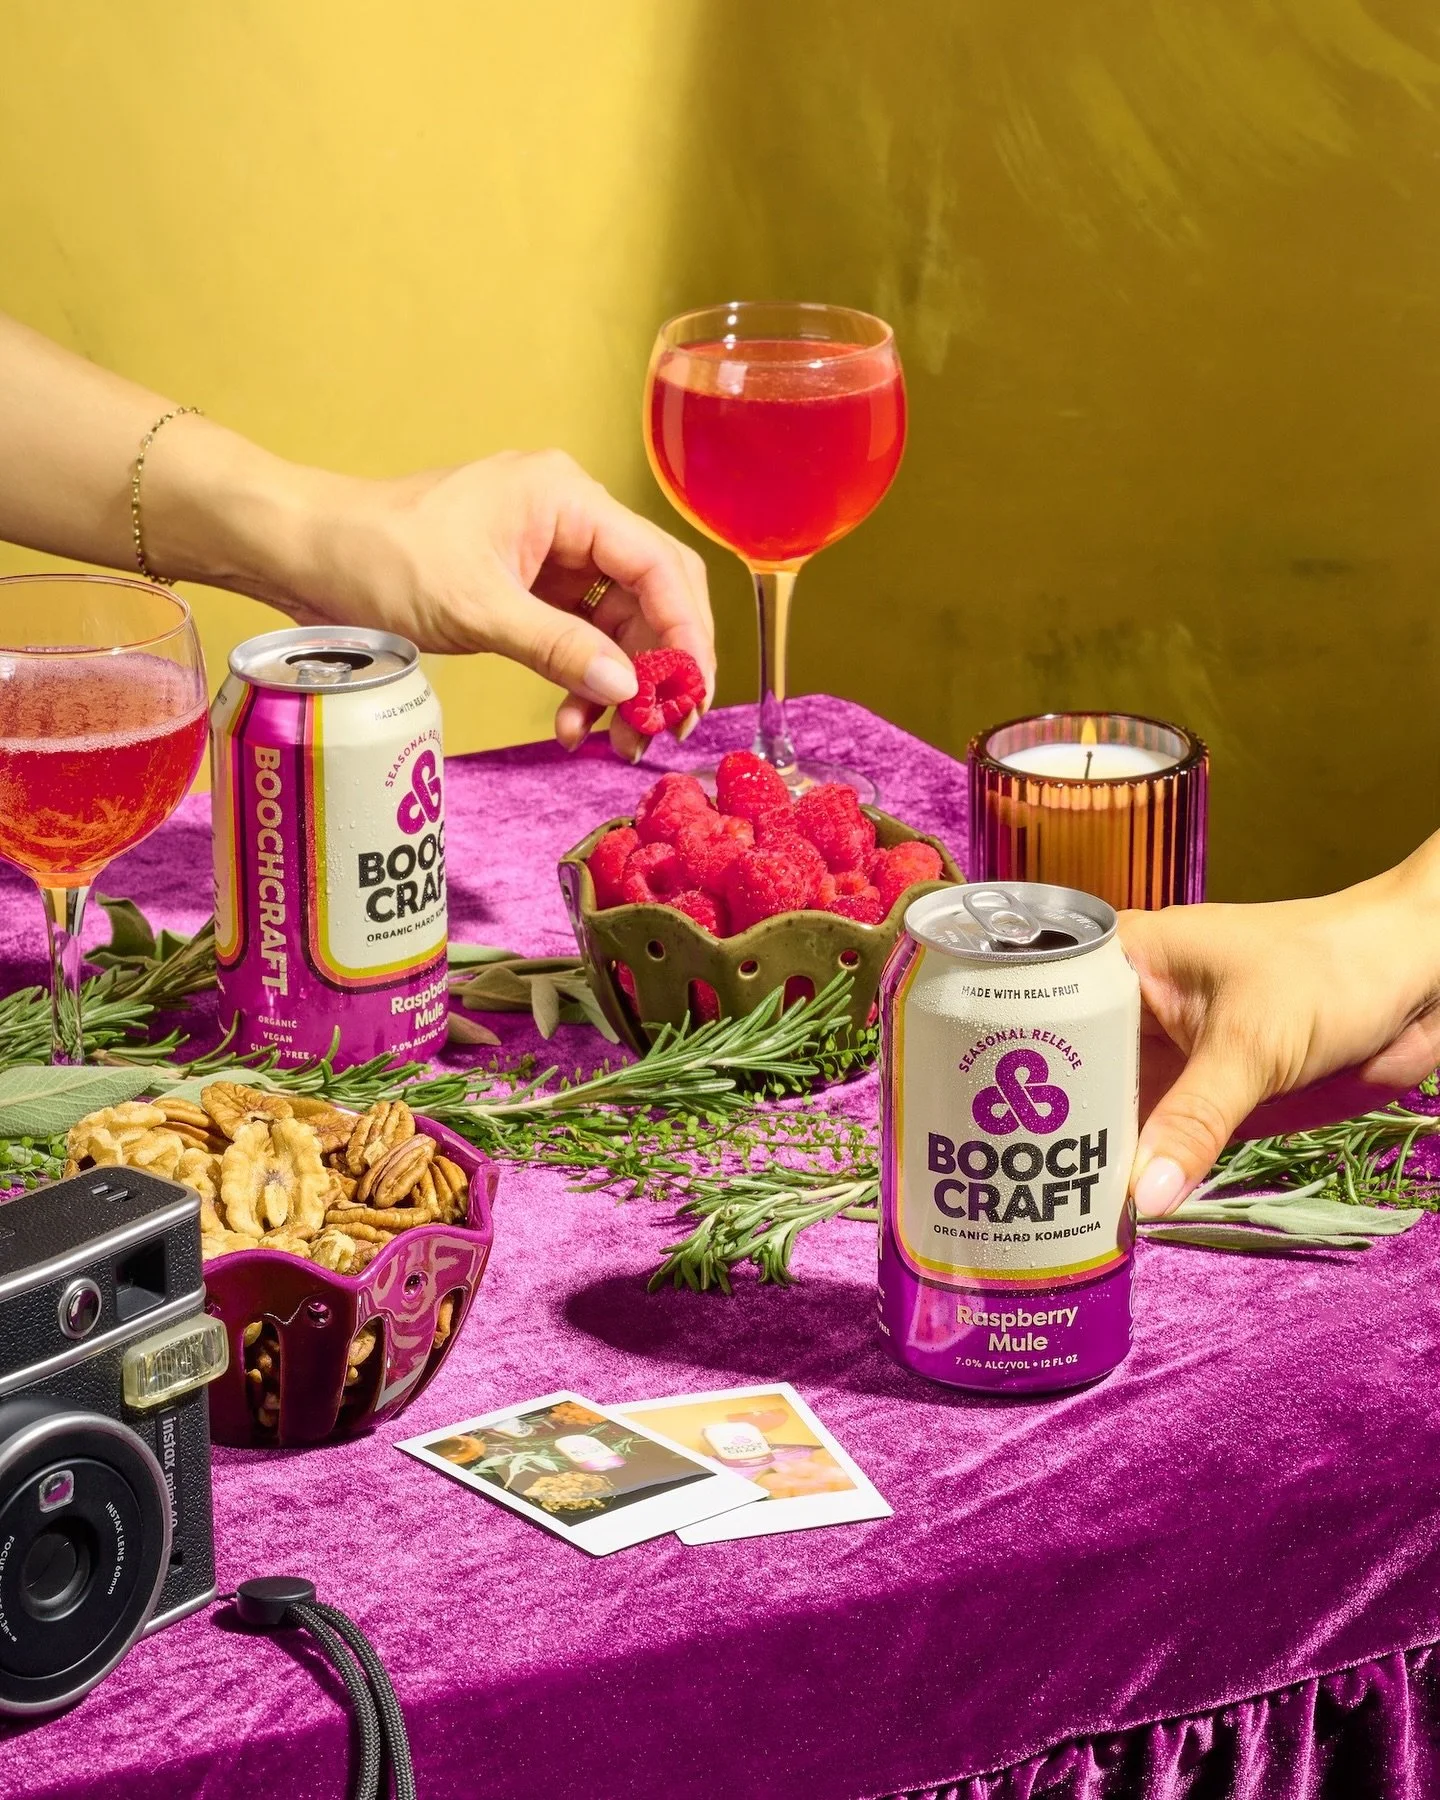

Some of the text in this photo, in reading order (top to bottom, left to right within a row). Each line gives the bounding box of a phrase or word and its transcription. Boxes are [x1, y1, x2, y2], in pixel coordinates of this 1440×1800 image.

[374, 707, 397, 720] MADE
[398, 701, 415, 714] WITH
[385, 732, 427, 787] SEASONAL
[254, 746, 288, 996] BOOCHCRAFT
[367, 915, 434, 942] ORGANIC HARD
[961, 984, 1080, 999] MADE WITH REAL FRUIT
[258, 1015, 297, 1028] ORGANIC
[414, 1002, 444, 1030] Mule
[263, 1031, 292, 1043] VEGAN
[391, 1041, 412, 1053] 7.0%
[958, 1028, 1082, 1073] SEASONAL RELEASE
[928, 1128, 1107, 1182] BOOCH
[934, 1172, 1099, 1224] CRAFT
[933, 1221, 1101, 1242] ORGANIC HARD KOMBUCHA
[956, 1304, 1079, 1332] Raspberry
[988, 1332, 1048, 1352] Mule
[955, 1354, 1078, 1369] 7.0% ALC/VOL 12 FL OZ
[162, 1416, 177, 1470] instax
[105, 1501, 125, 1595] INSTAX LENS 60mm
